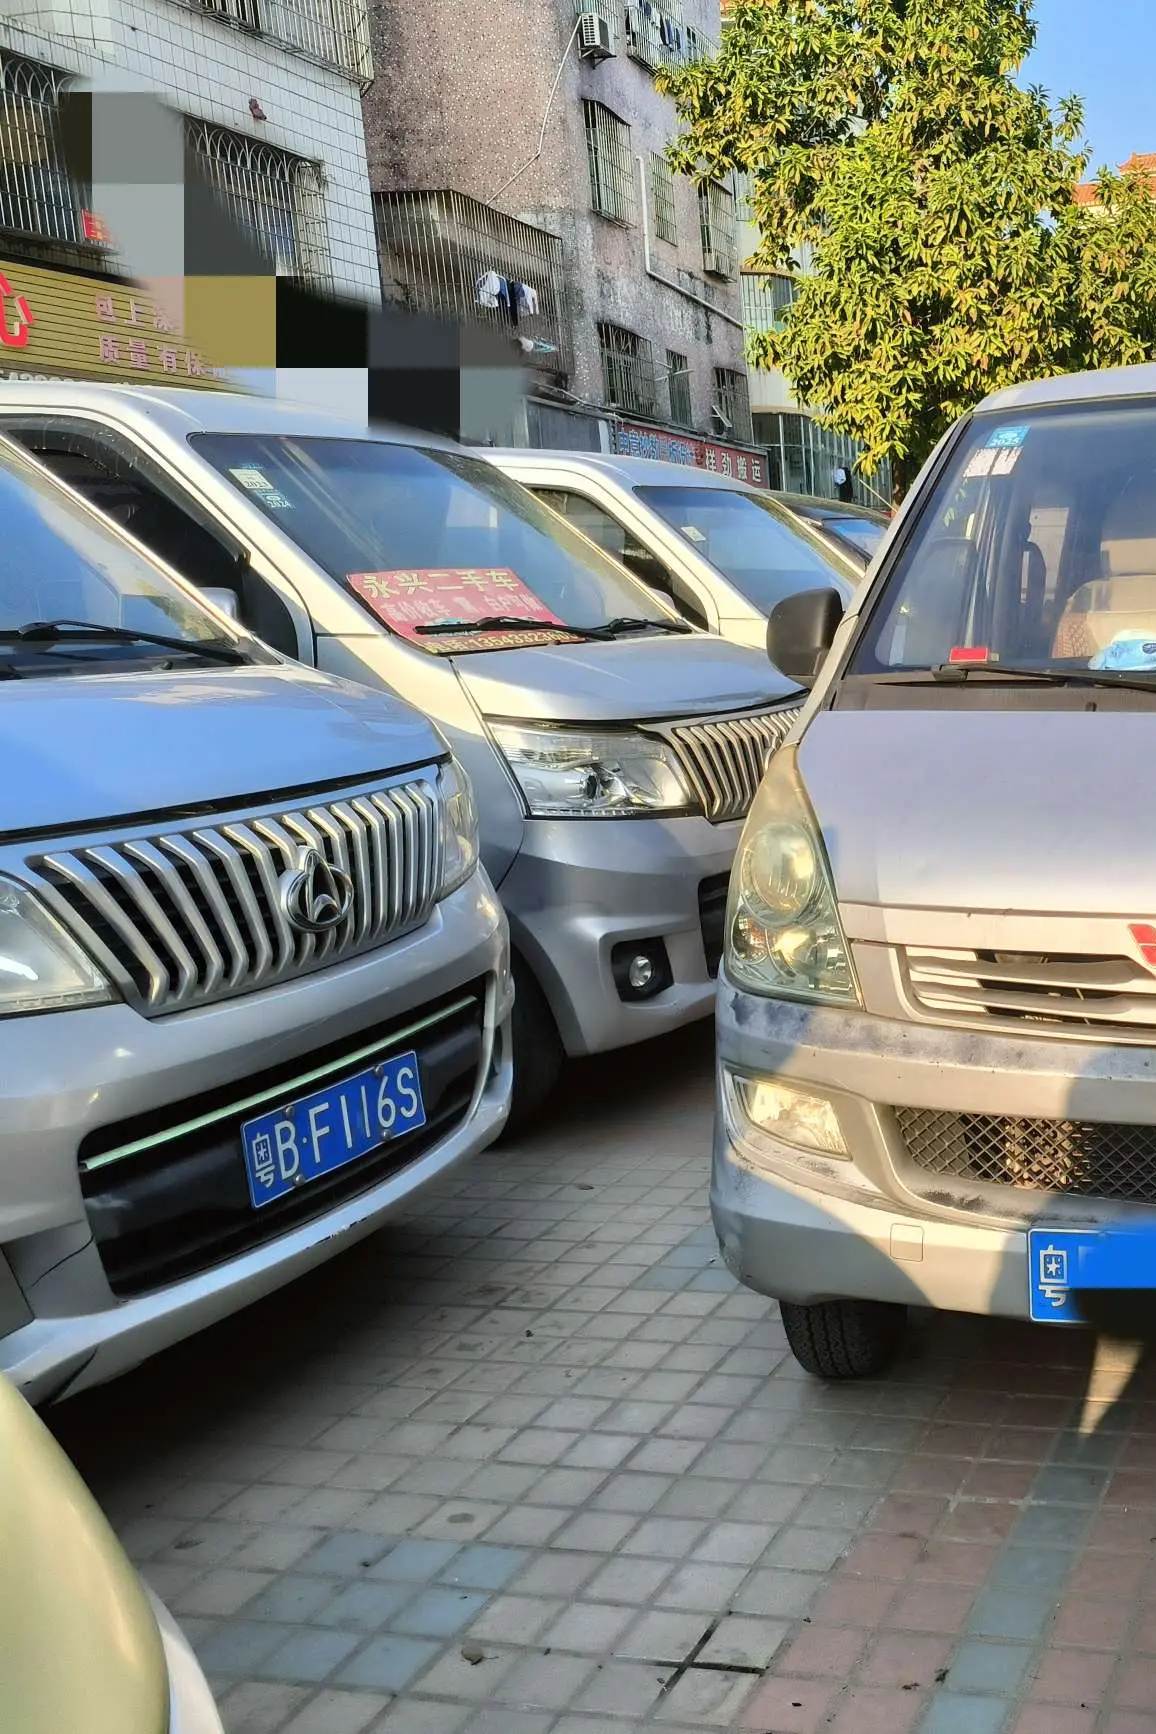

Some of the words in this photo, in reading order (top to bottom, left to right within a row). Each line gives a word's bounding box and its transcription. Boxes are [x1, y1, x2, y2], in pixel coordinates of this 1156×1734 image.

[364, 570, 519, 598] 永兴二手车
